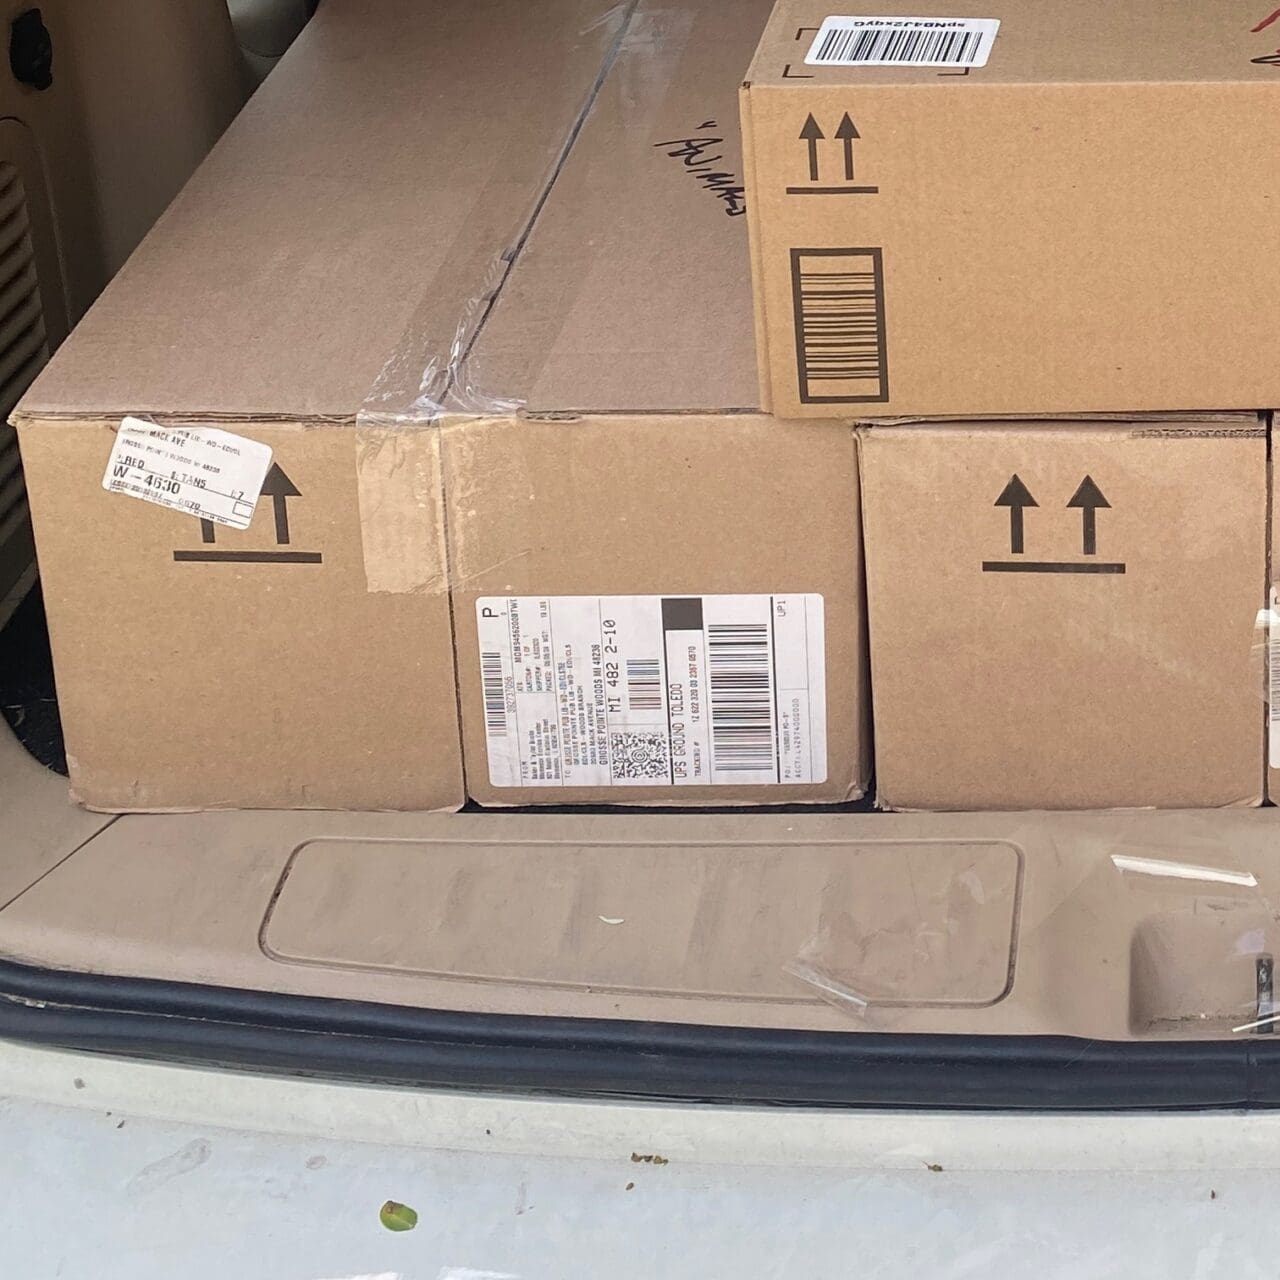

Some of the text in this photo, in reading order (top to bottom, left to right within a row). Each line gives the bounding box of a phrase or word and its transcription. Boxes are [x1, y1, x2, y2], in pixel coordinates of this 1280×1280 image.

[481, 606, 499, 618] P
[776, 600, 786, 617] UP1
[592, 666, 602, 676] MI
[602, 619, 621, 712] MI 482 2-10
[593, 678, 604, 706] WOODS
[595, 708, 606, 734] POINTE
[669, 682, 687, 777] UPS GROUND TOLEDO
[597, 736, 608, 765] GROSSE
